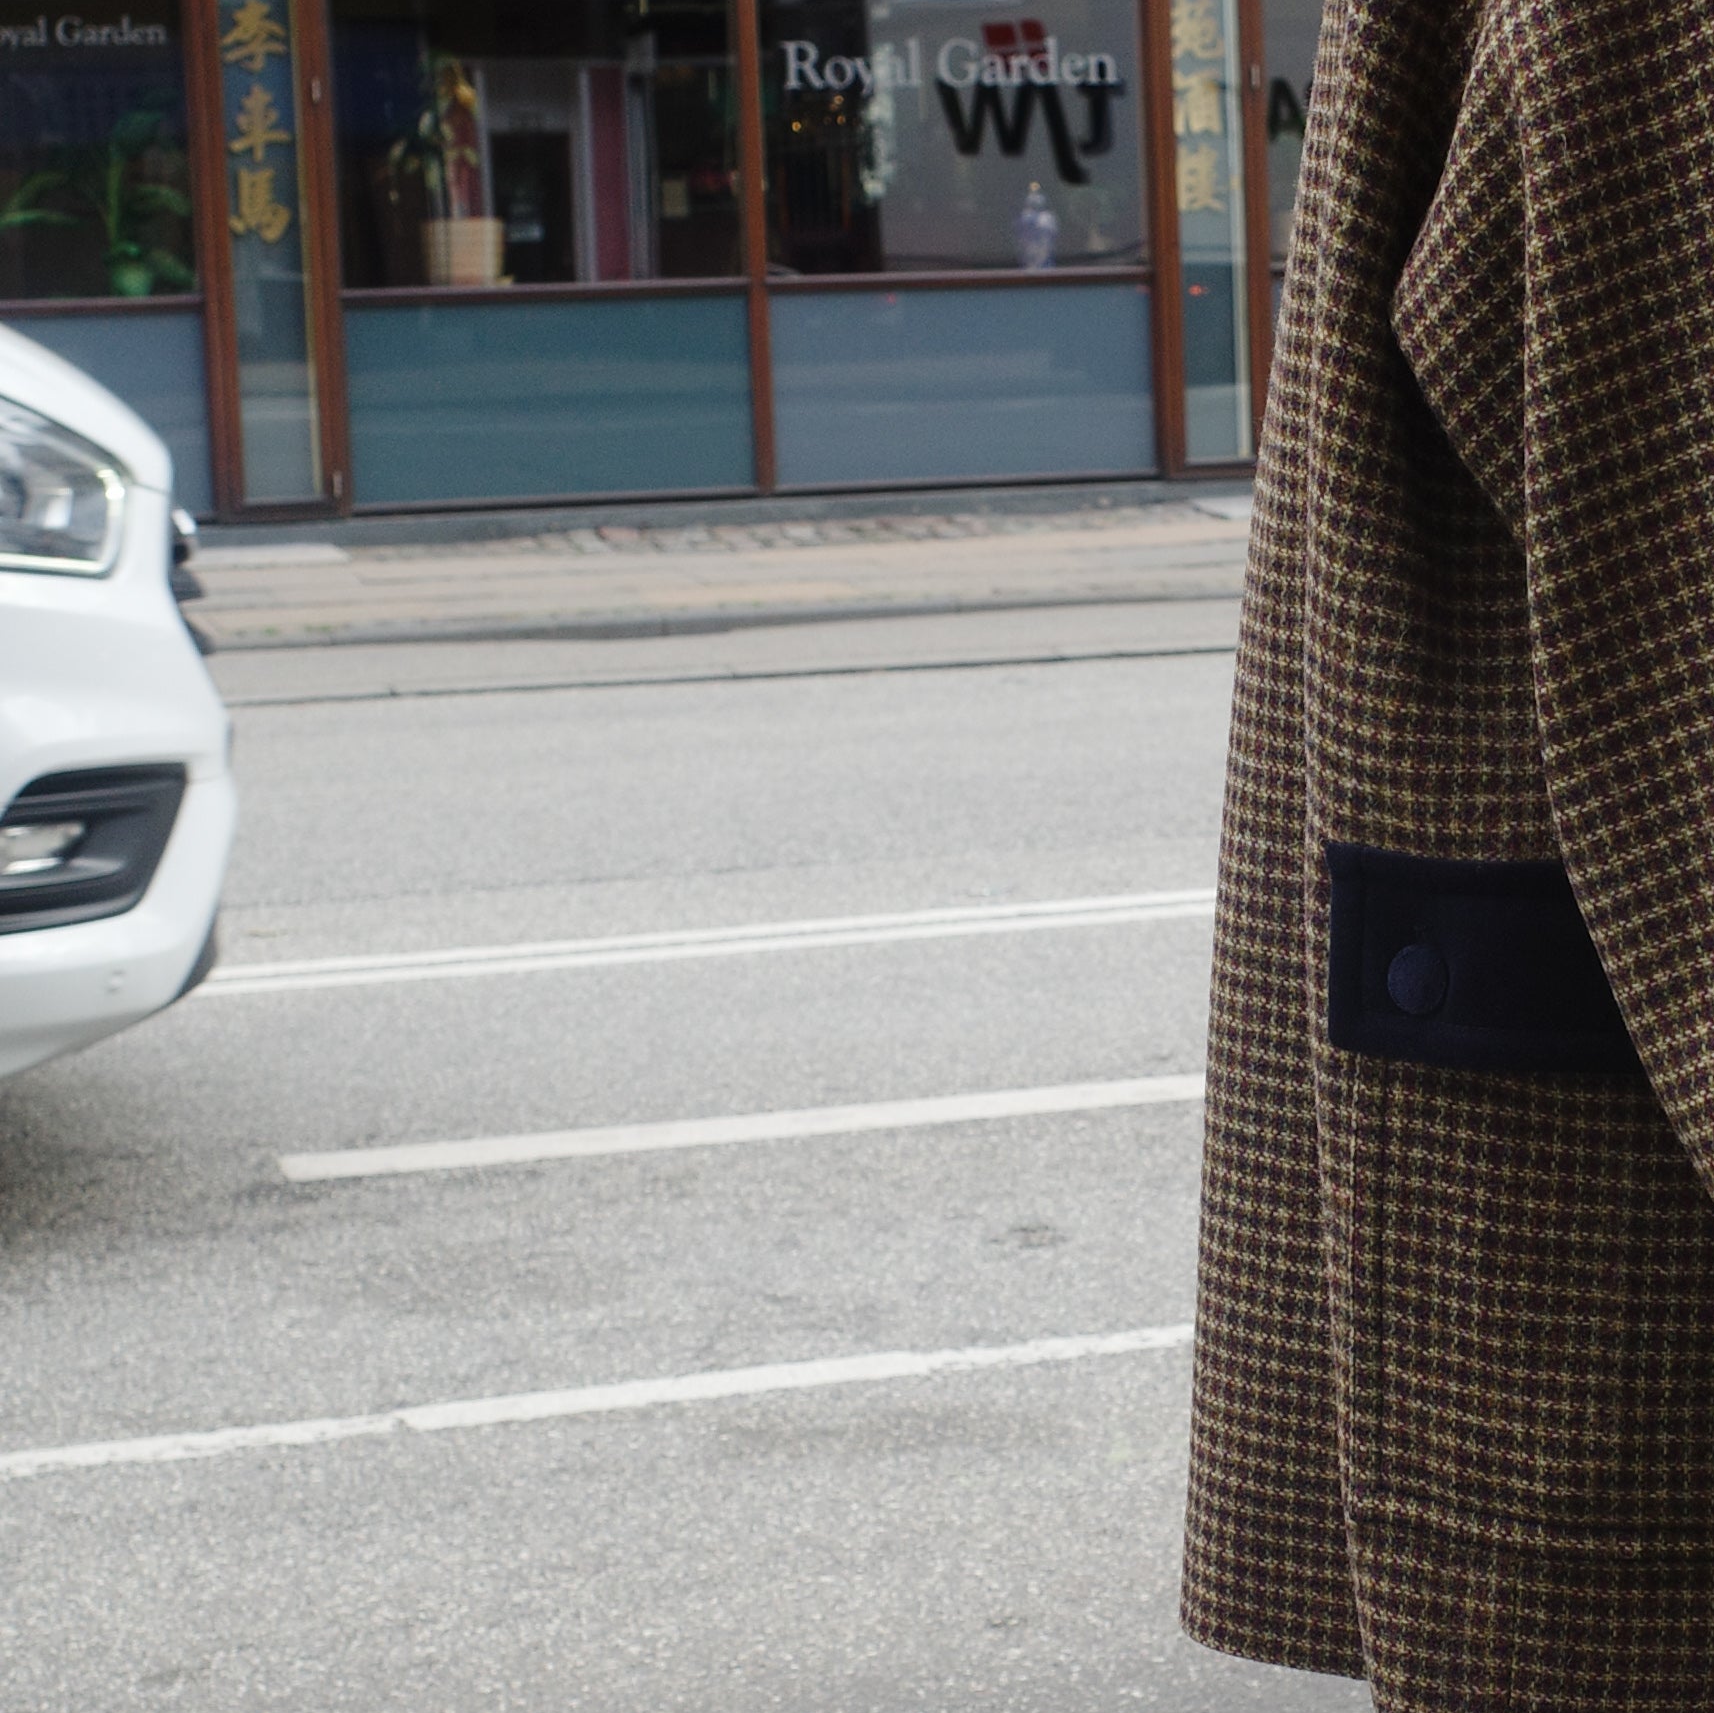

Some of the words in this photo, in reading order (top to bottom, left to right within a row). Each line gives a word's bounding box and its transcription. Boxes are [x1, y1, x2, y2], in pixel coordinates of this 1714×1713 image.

[54, 14, 168, 47] Garden
[780, 36, 921, 96] Royal
[936, 35, 1121, 86] Garden
